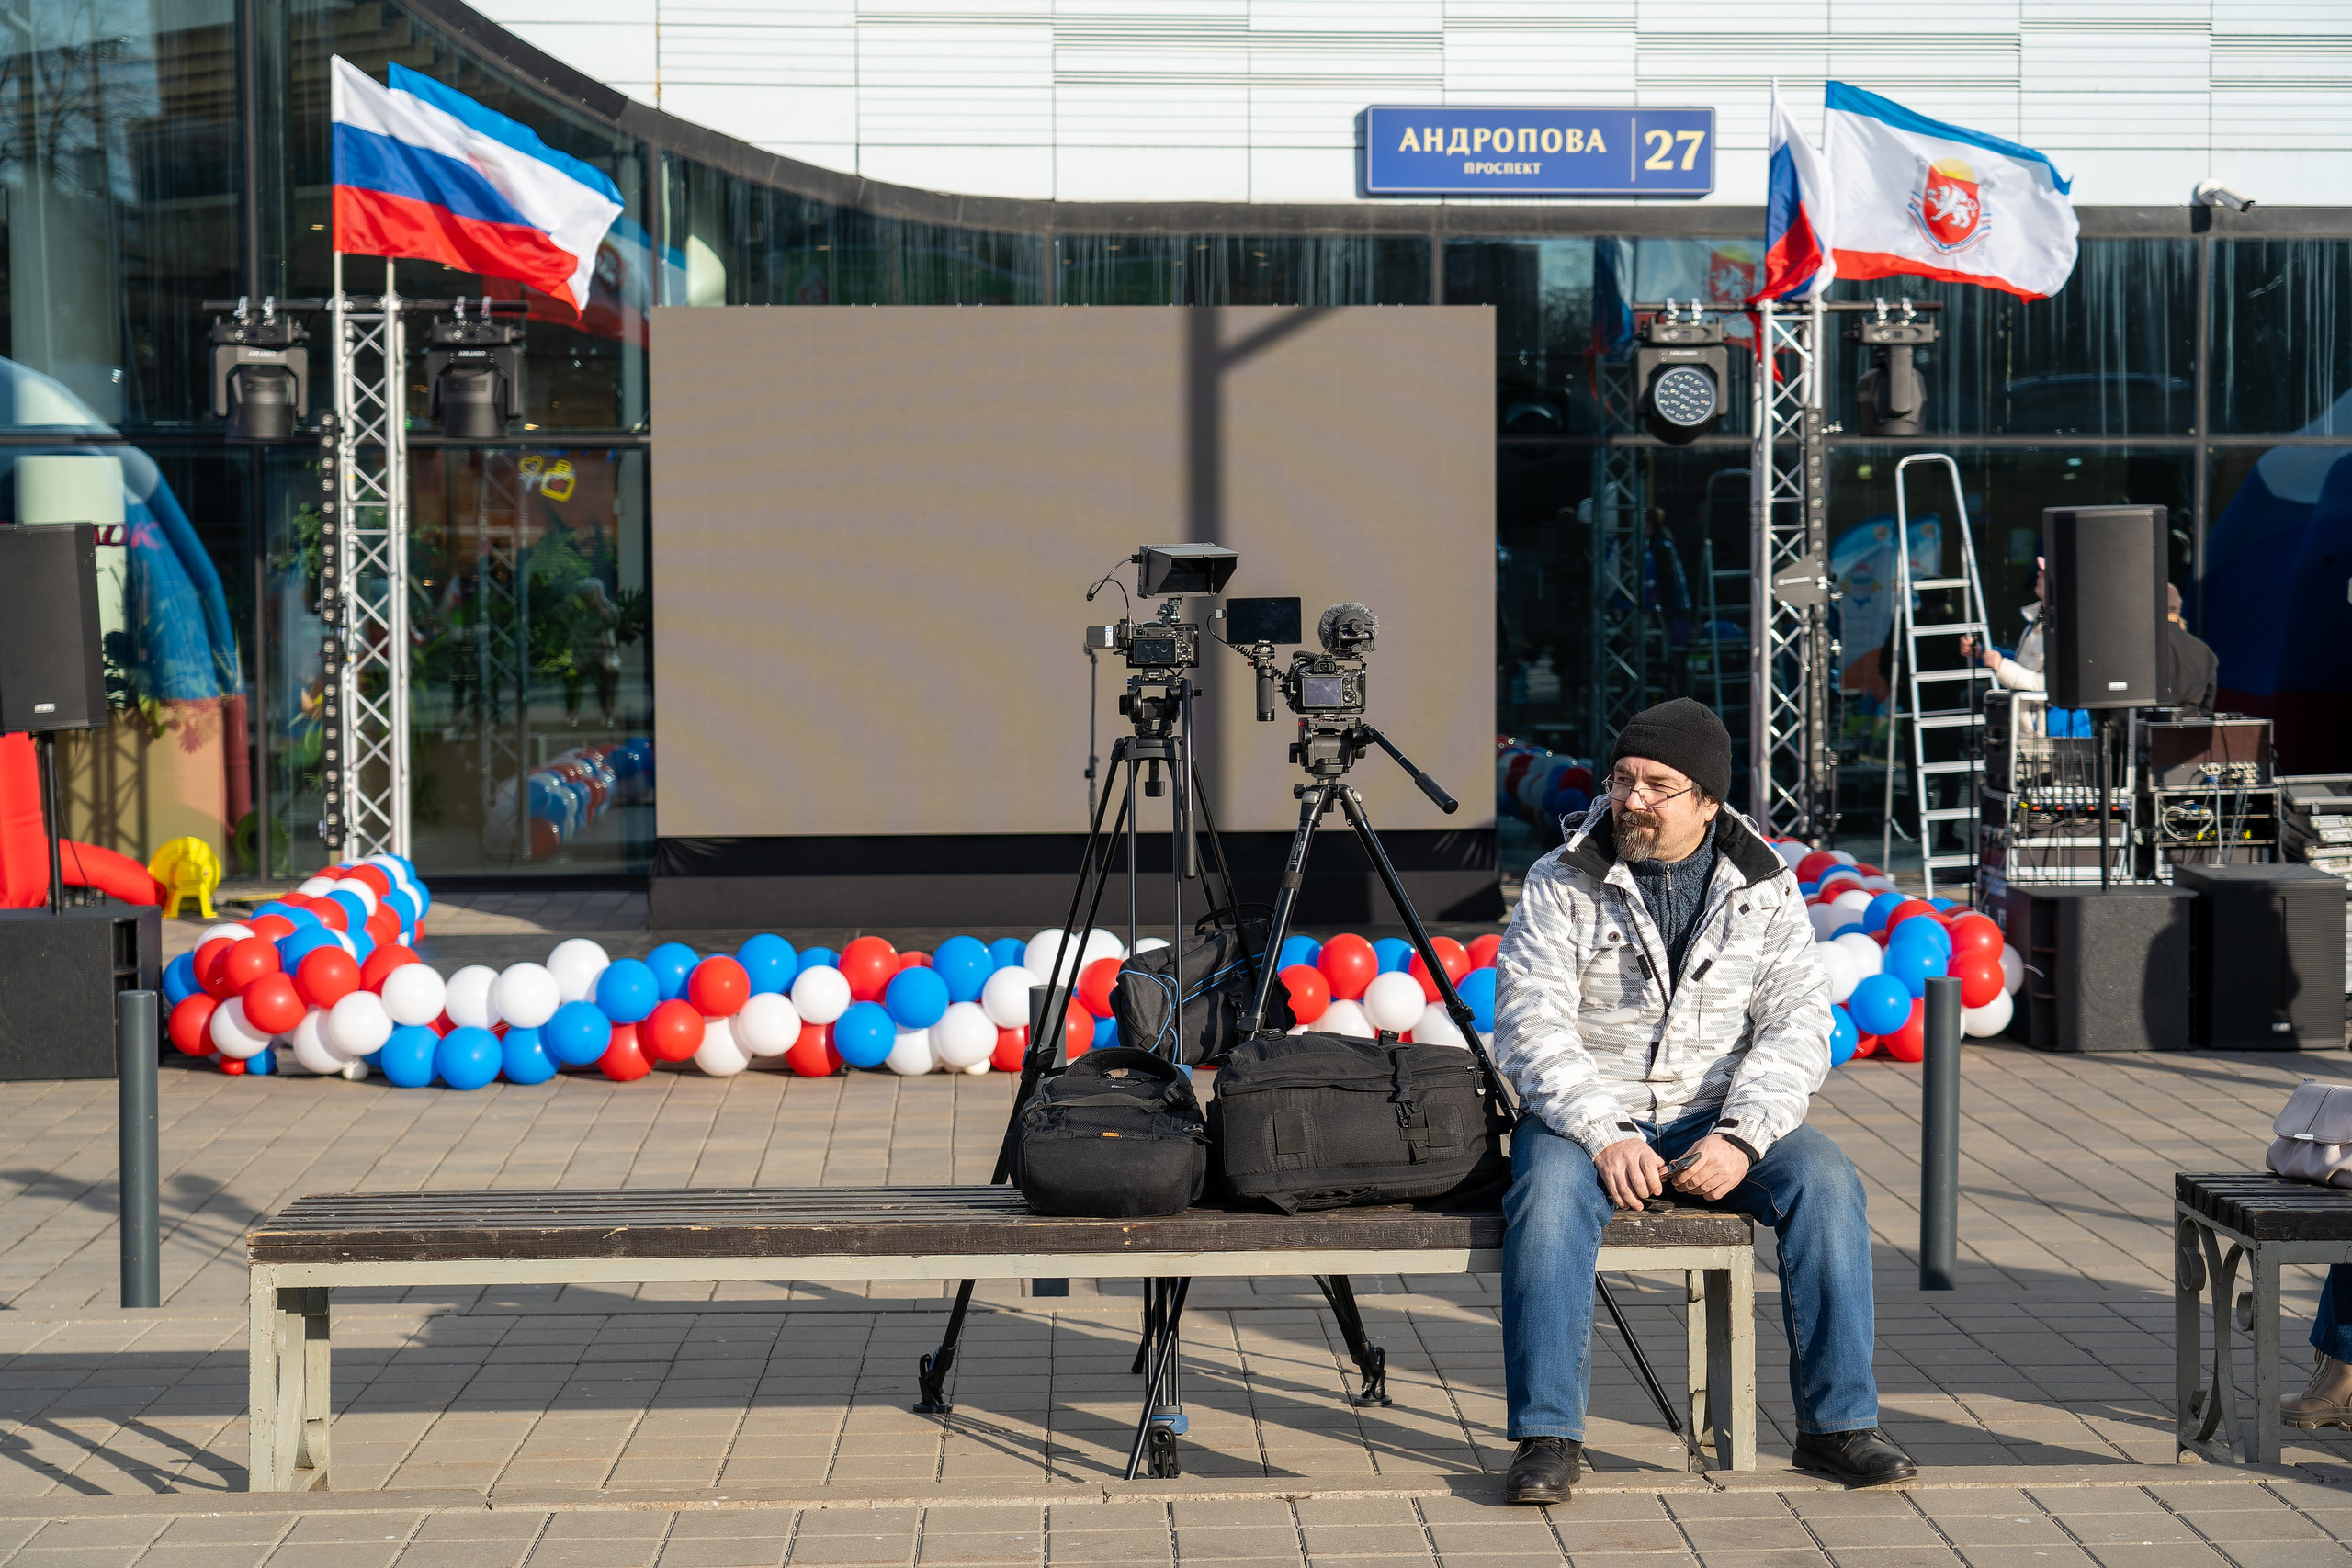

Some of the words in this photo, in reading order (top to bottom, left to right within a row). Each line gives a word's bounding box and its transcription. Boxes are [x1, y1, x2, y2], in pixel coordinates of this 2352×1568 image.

[1398, 127, 1607, 155] АНДРОПОВА
[1644, 130, 1706, 171] 27
[1464, 162, 1543, 175] ПРОСПЕКТ
